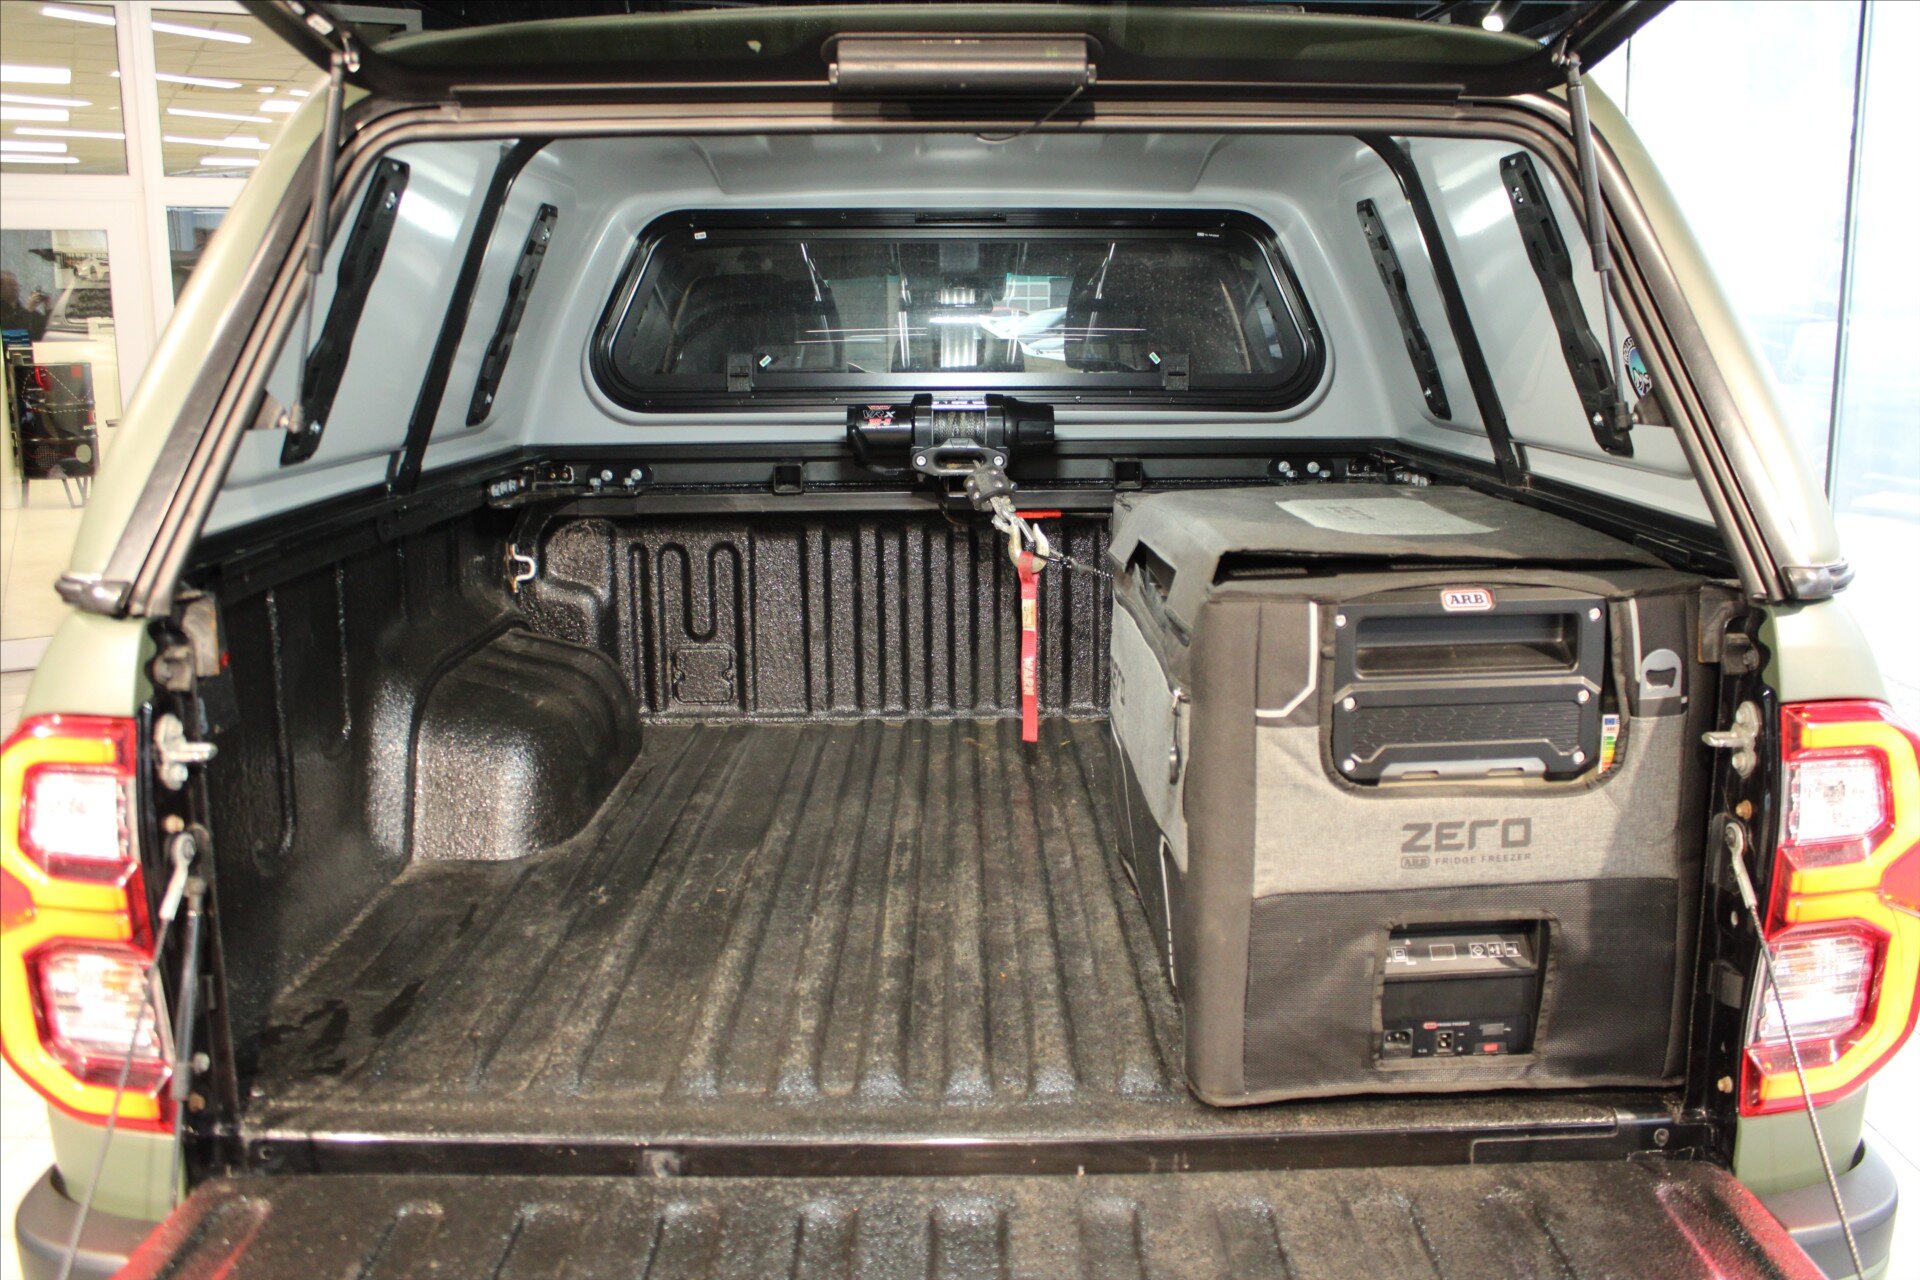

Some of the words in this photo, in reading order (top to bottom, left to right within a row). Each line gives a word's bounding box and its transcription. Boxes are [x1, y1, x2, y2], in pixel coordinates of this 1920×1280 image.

[1450, 594, 1484, 605] ARB
[1023, 656, 1035, 696] WARN
[1435, 856, 1476, 865] FRIDGE
[1481, 853, 1532, 863] FREEZER
